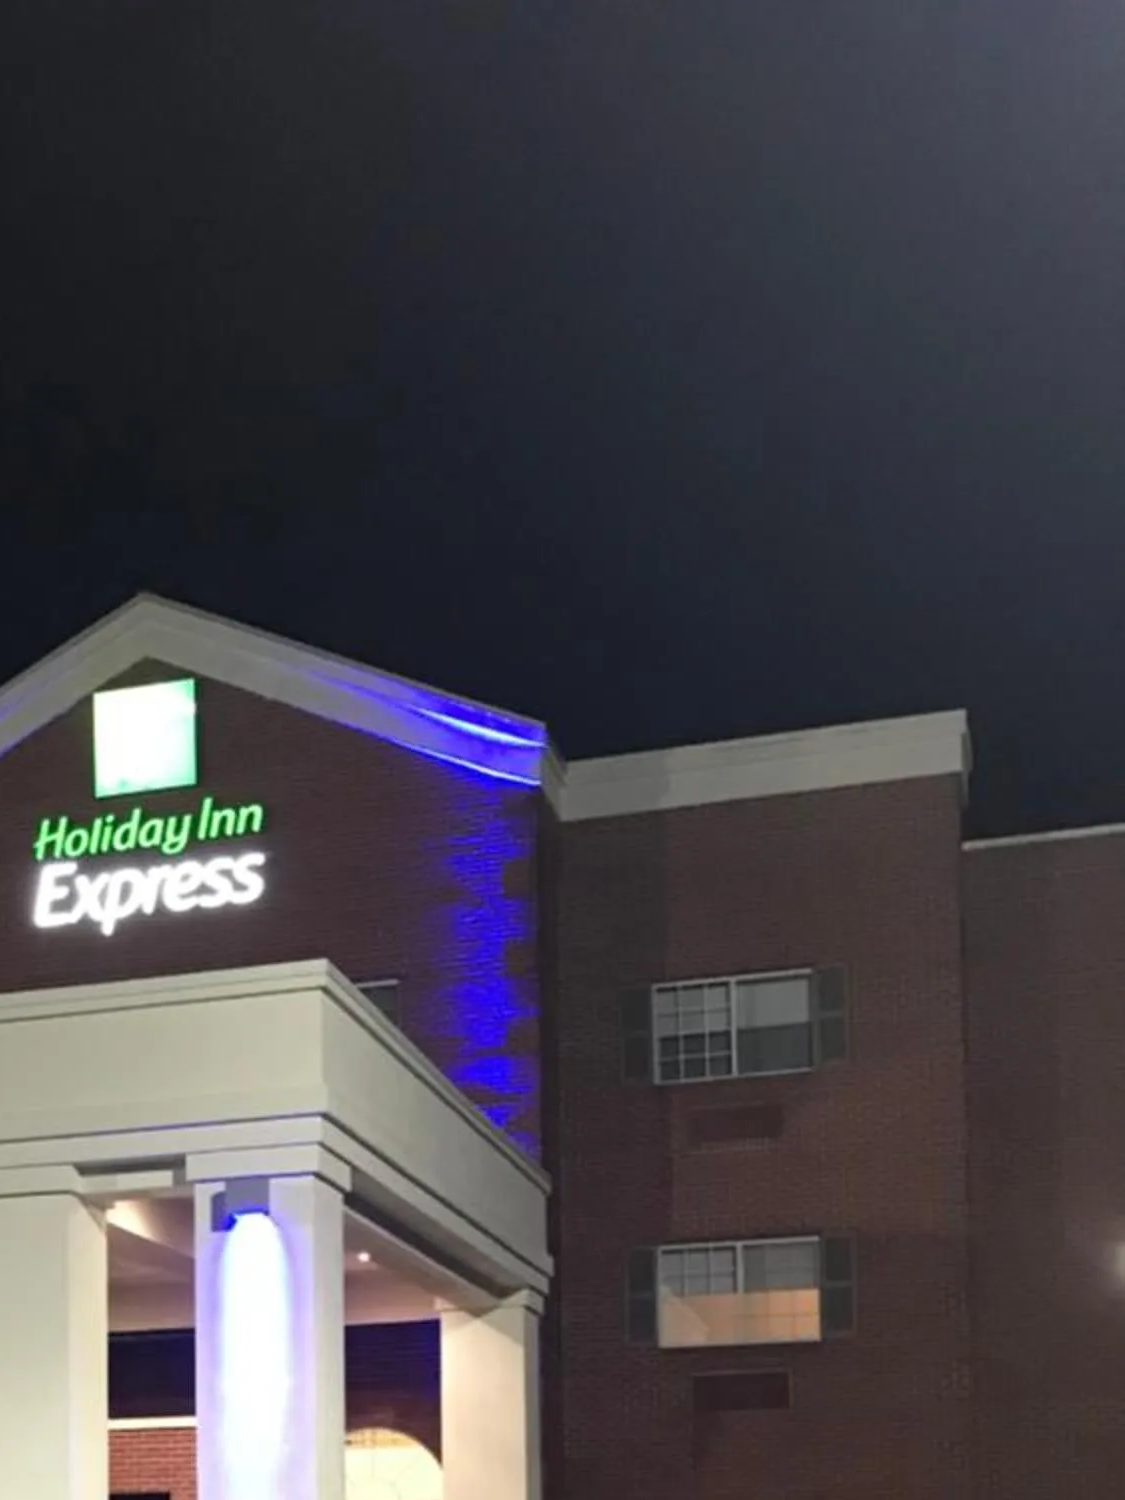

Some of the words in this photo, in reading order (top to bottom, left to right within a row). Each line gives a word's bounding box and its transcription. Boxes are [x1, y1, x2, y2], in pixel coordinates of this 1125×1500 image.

[34, 808, 193, 861] Holiday
[197, 797, 263, 840] Inn
[32, 851, 267, 937] Express
